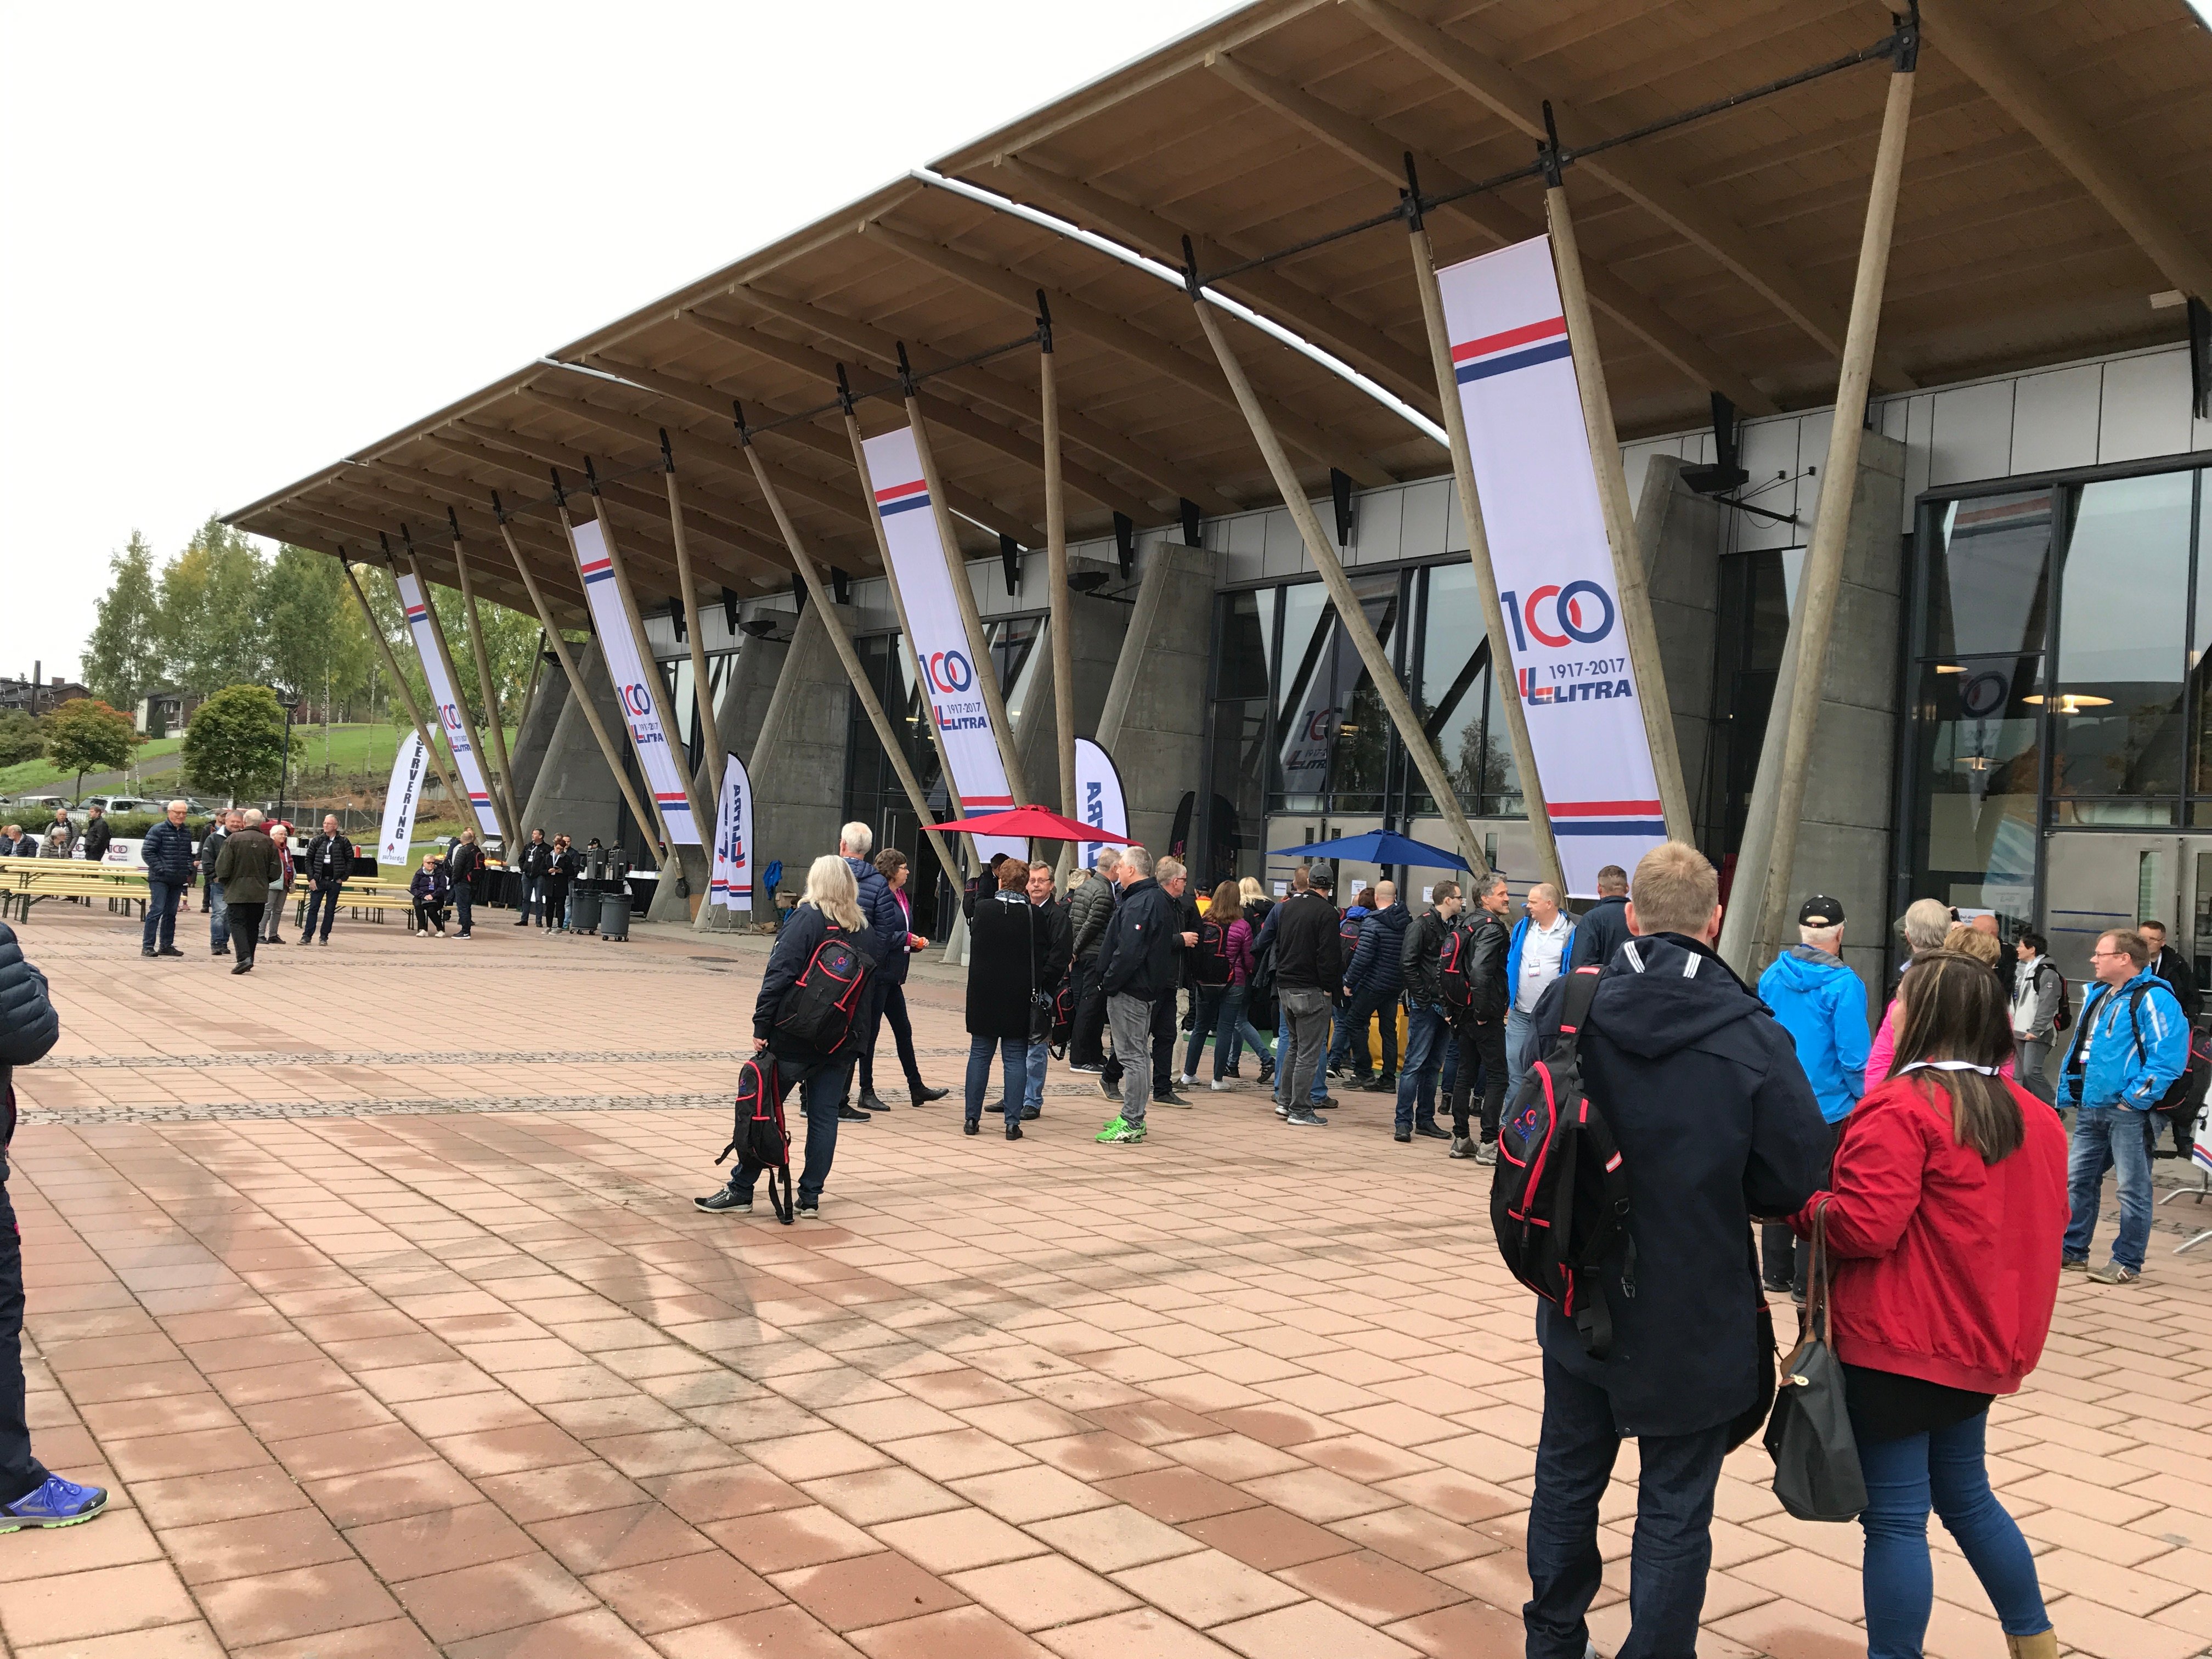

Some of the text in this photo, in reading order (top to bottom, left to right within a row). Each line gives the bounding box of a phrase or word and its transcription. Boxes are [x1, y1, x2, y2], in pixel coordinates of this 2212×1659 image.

[1501, 580, 1615, 652] 100
[918, 650, 972, 695] 100
[1549, 658, 1625, 680] 1917-2017
[617, 684, 651, 717] 100
[1553, 679, 1633, 704] LITRA
[438, 704, 462, 730] 100
[947, 702, 980, 714] 1917-2017
[952, 716, 988, 730] LITRA
[395, 735, 425, 839] SERVERING
